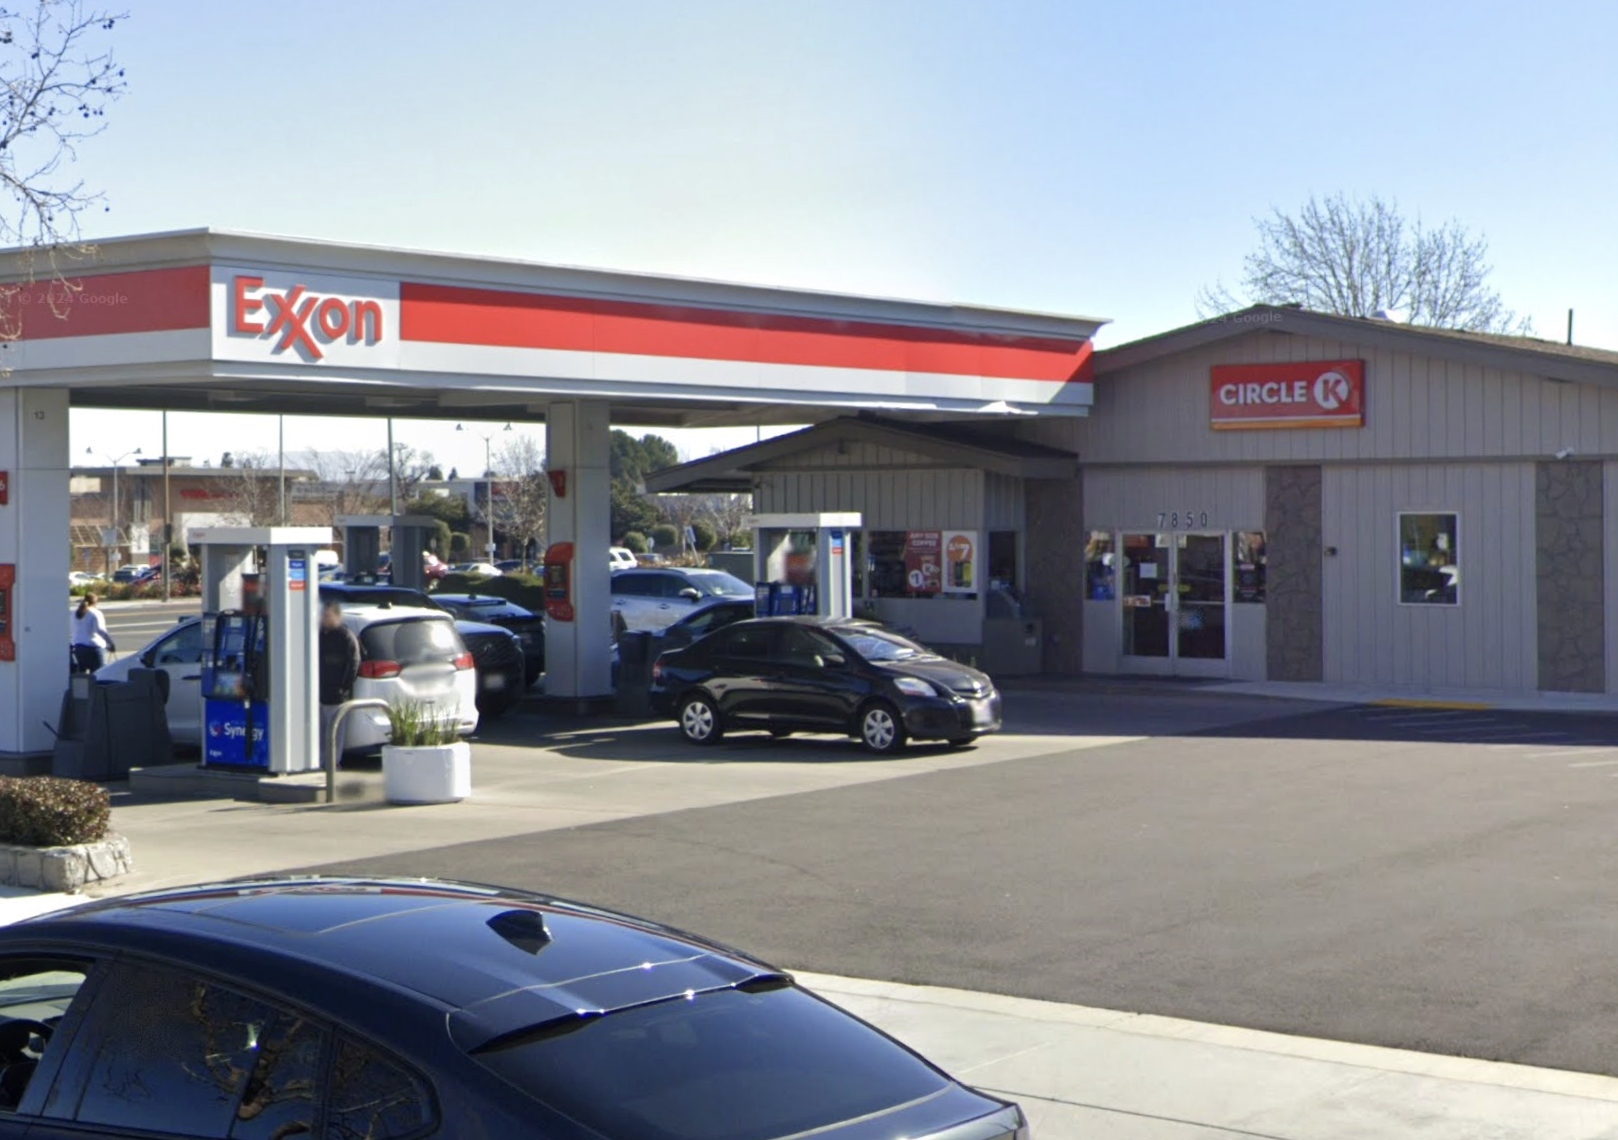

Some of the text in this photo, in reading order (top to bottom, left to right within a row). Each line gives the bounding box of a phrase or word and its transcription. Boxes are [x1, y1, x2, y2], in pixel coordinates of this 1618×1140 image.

[234, 275, 383, 359] Exxon
[1219, 375, 1348, 408] CIRCLE K
[1158, 511, 1208, 529] 7850
[224, 722, 264, 741] Synegy
